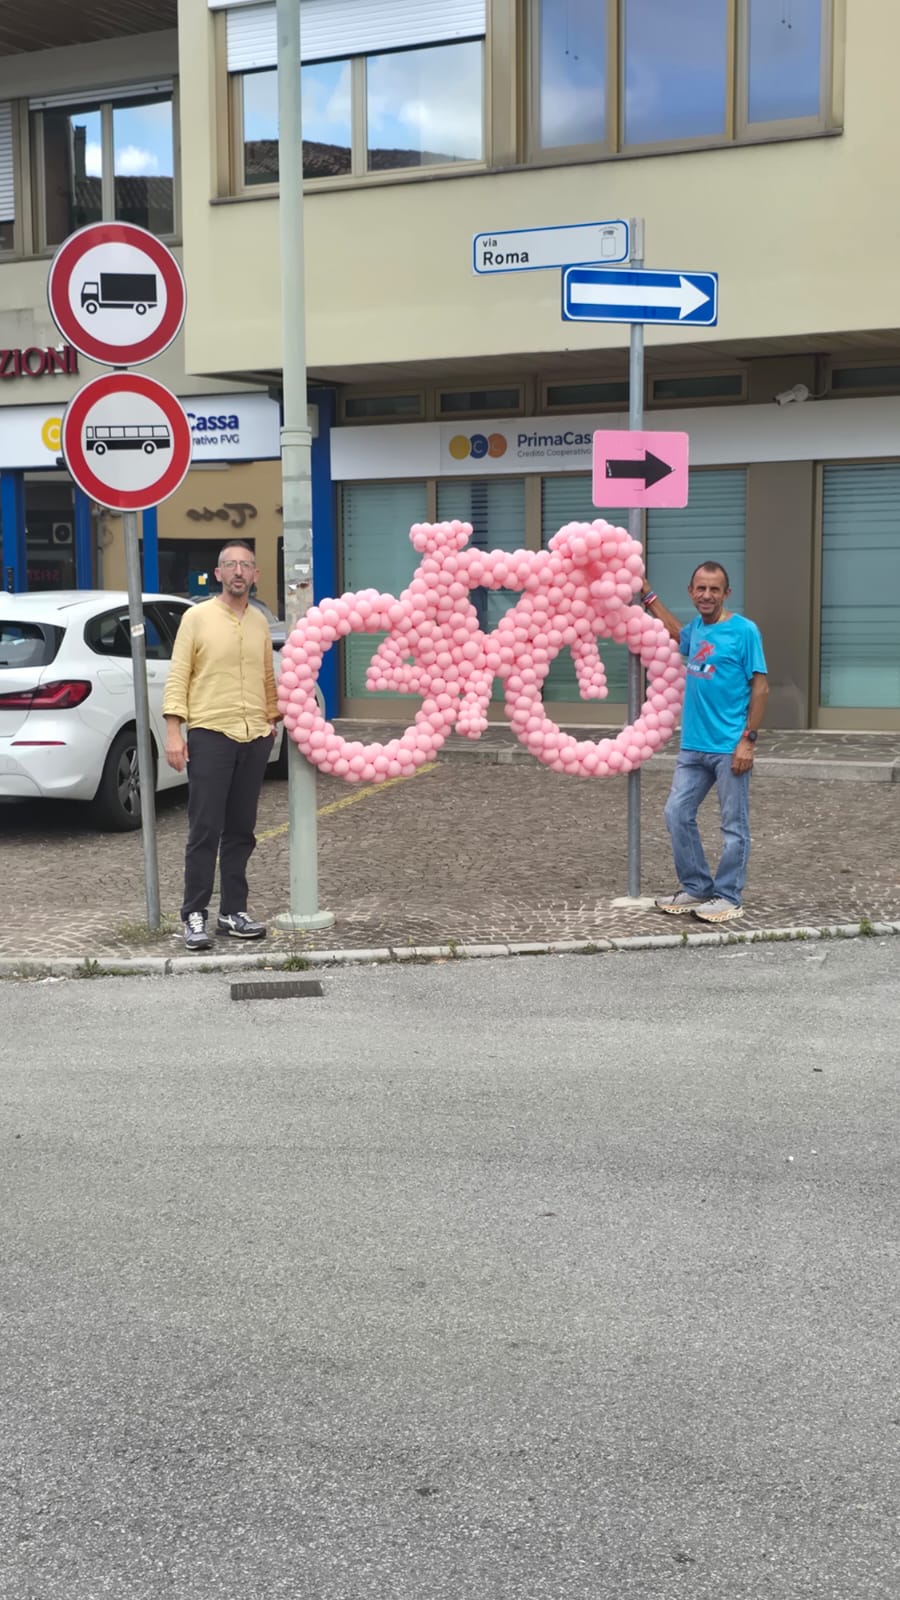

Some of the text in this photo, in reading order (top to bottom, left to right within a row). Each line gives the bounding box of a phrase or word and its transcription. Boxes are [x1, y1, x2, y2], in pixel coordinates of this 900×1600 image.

[482, 238, 498, 248] via
[483, 251, 529, 266] Roma
[220, 433, 240, 444] FVG
[517, 432, 593, 447] PrimaCas
[517, 447, 592, 458] Credito Cooperativo
